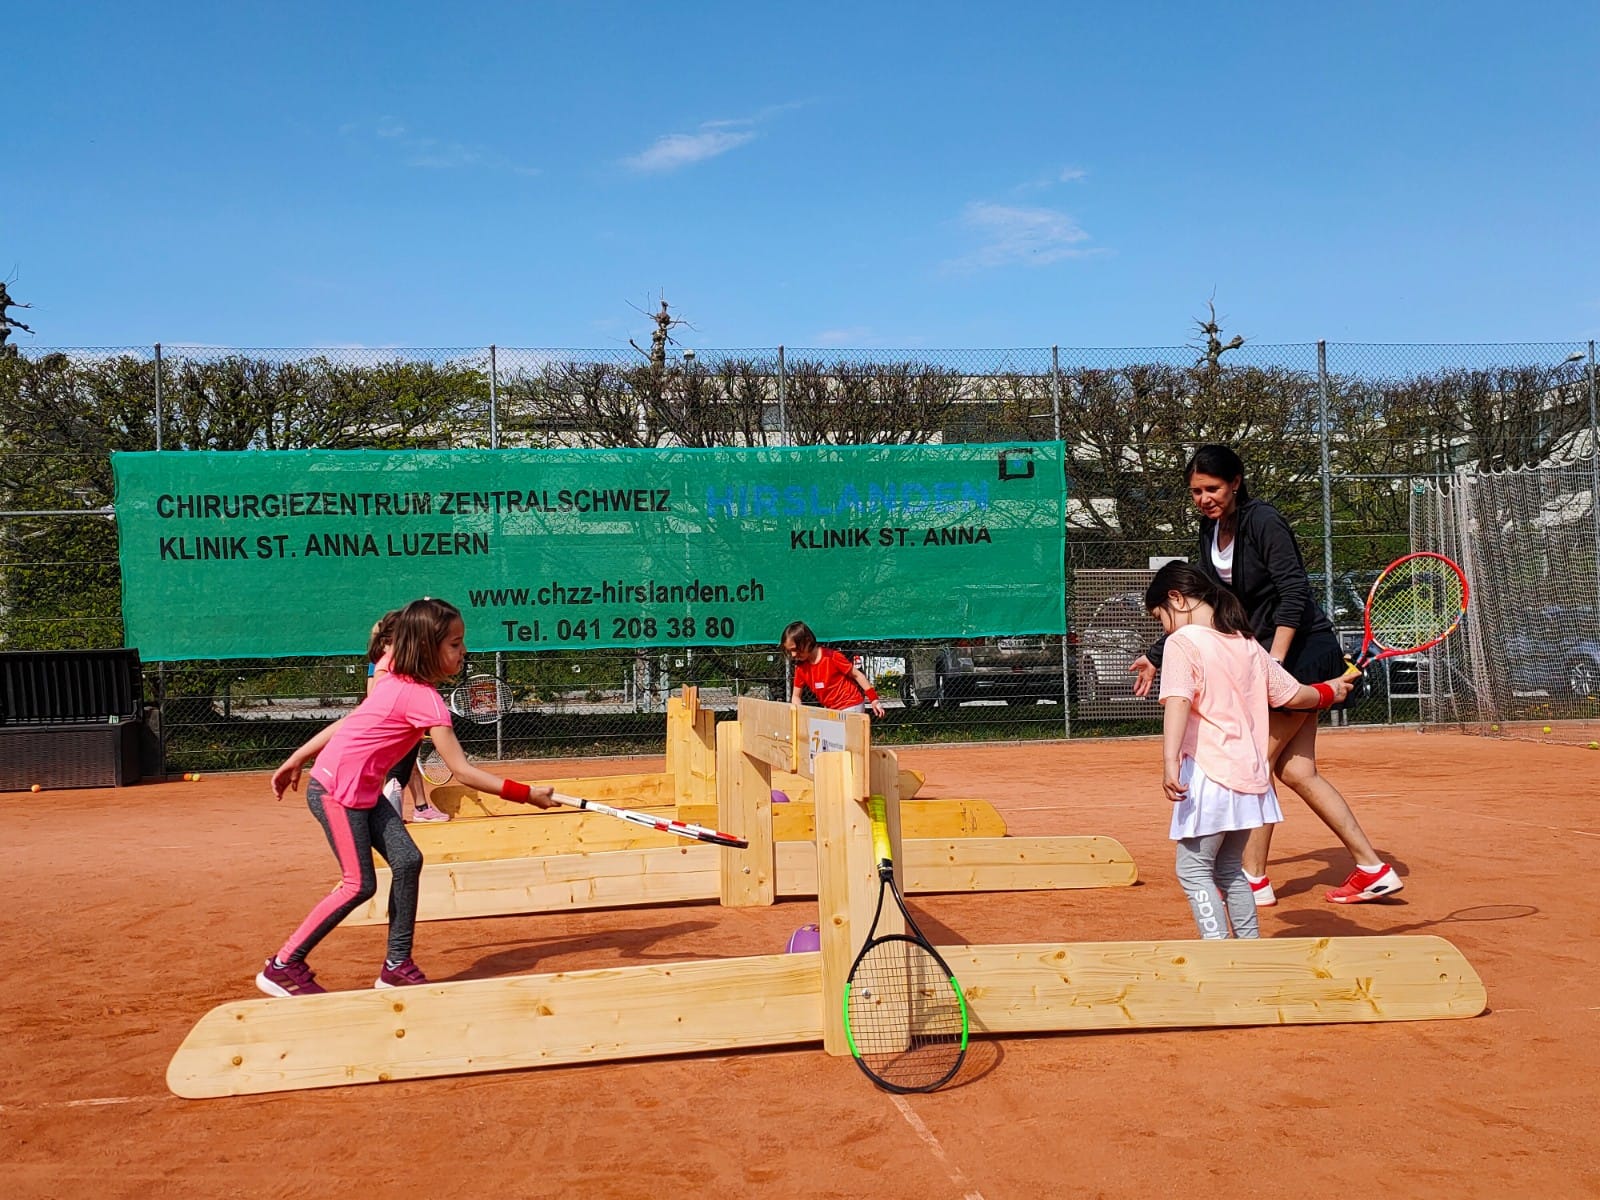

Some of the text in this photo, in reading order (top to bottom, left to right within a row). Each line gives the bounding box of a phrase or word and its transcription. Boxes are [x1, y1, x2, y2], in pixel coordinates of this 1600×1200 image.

[156, 489, 671, 519] CHIRURGIEZENTRUM ZENTRALSCHWEIZ
[706, 481, 990, 518] HIRSLANDEN
[160, 532, 489, 560] KLINIK ST. ANNA LUZERN
[790, 526, 992, 550] KLINIK ST. ANNA
[468, 578, 764, 607] www.chzz-hirslanden.ch
[503, 616, 735, 642] Tel. 041 208 38 80
[1195, 889, 1221, 940] idas
